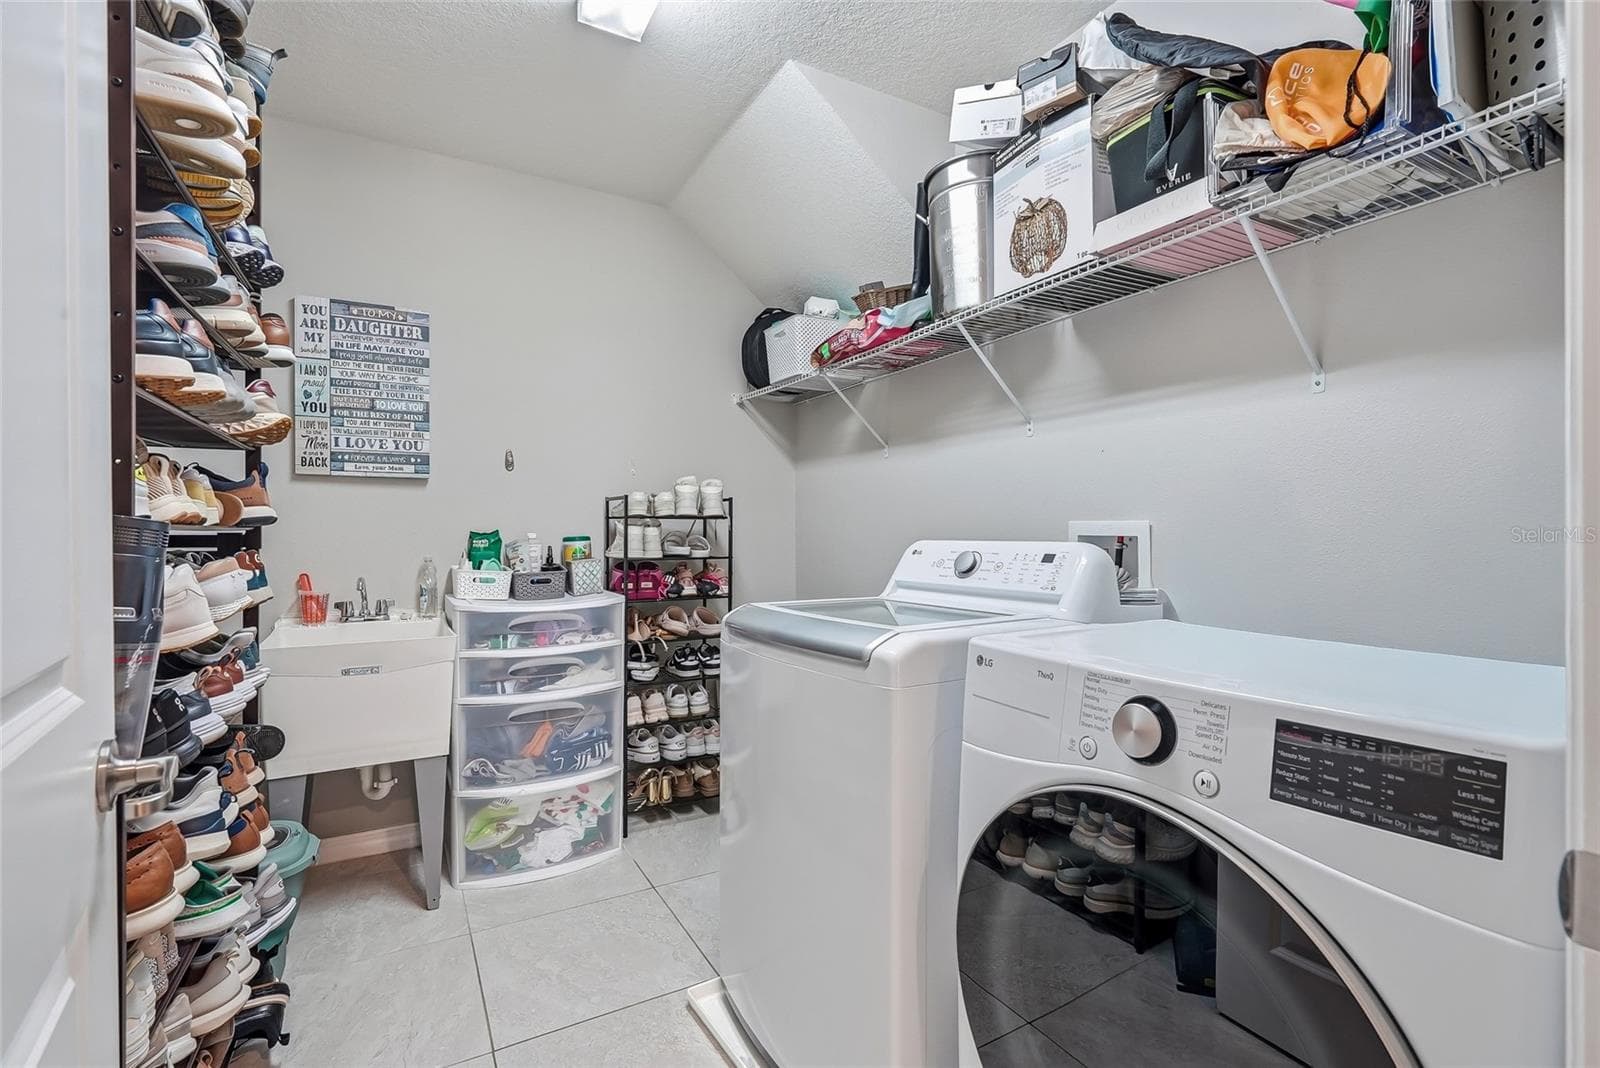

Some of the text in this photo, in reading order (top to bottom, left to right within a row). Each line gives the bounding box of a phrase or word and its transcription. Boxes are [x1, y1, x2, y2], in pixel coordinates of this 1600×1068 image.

[1156, 172, 1191, 194] EVERIE
[302, 304, 327, 316] YOU
[362, 308, 396, 320] TO MY
[300, 318, 328, 330] ARE
[334, 317, 422, 340] DAUGHTER
[304, 332, 324, 342] MY
[300, 344, 327, 354] sunshine
[304, 364, 316, 376] AM
[318, 366, 328, 377] SO
[405, 366, 424, 374] FORGET
[302, 378, 326, 388] proud
[399, 375, 419, 384] HOME
[301, 402, 326, 413] YOU
[374, 400, 424, 411] TO LOVE YOU
[303, 420, 316, 429] LOVE
[318, 421, 328, 430] YOU
[301, 434, 328, 450] Moon
[334, 437, 424, 452] I LOVE YOU
[300, 456, 328, 468] BACK
[984, 658, 993, 667] LG
[1038, 670, 1054, 680] ThinQ
[1200, 700, 1226, 710] Delicates
[1210, 711, 1226, 720] Press
[1195, 730, 1224, 743] Speed Dry
[1212, 745, 1222, 754] Dry
[1188, 750, 1222, 764] Downloaded
[1457, 765, 1498, 779] More Time
[1274, 788, 1292, 798] Energy
[1457, 790, 1495, 804] Less Time
[1312, 798, 1339, 810] Dry Level
[1378, 815, 1407, 830] Time Dry
[1452, 811, 1499, 828] Wrinkle Care
[1469, 838, 1479, 846] Dry
